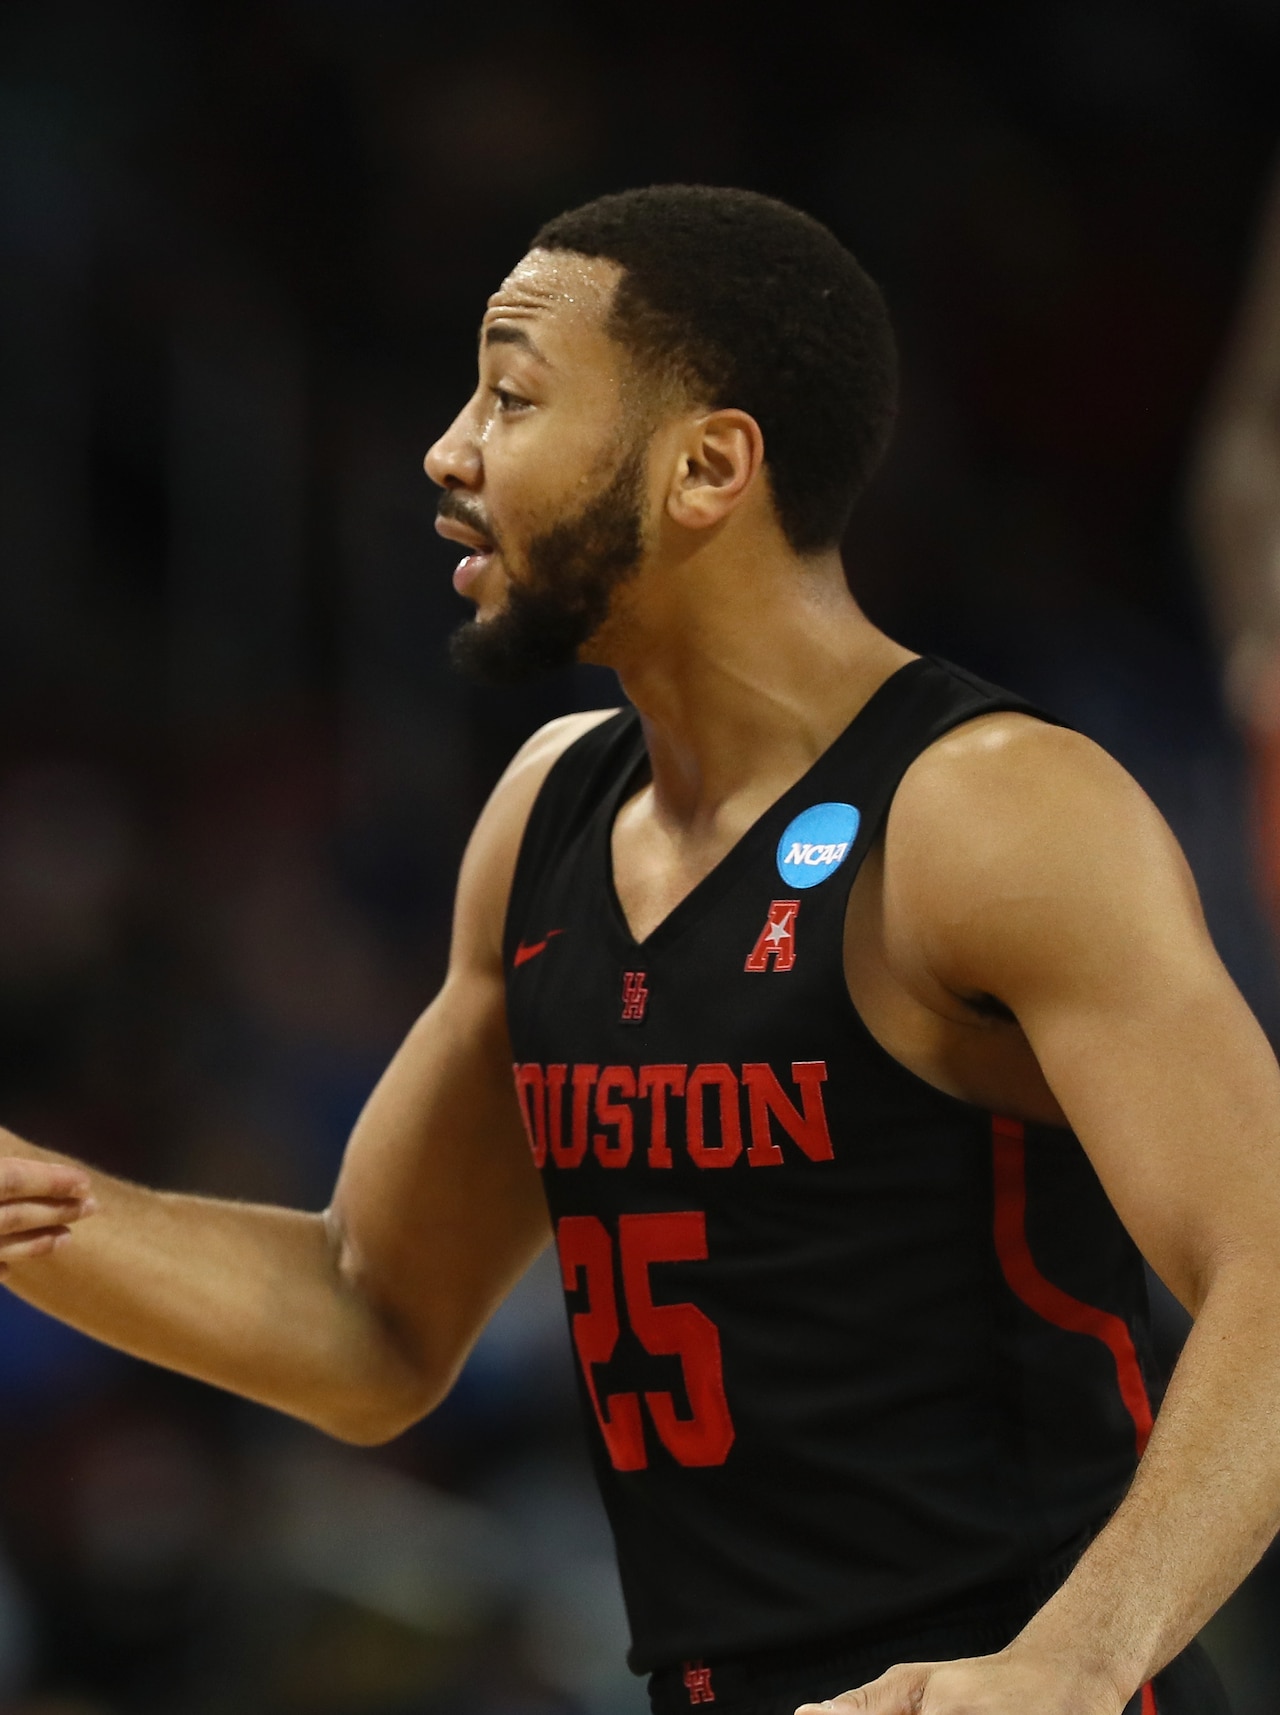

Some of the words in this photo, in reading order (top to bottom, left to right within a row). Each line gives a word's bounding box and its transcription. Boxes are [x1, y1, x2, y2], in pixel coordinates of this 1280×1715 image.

[784, 842, 848, 866] NCAA
[512, 1061, 835, 1169] OUSTON
[558, 1211, 736, 1471] 25
